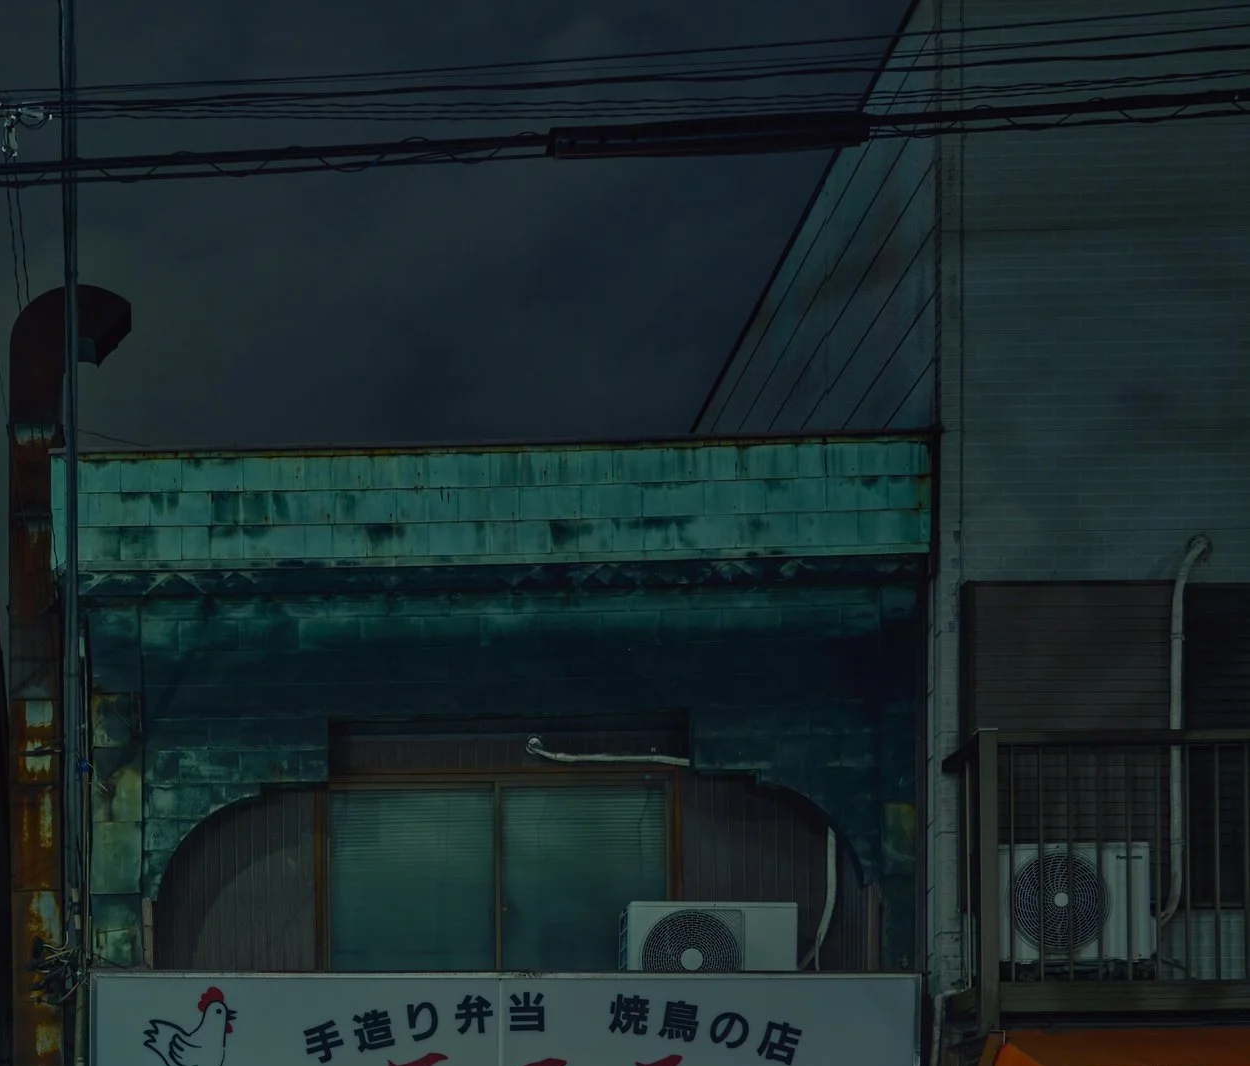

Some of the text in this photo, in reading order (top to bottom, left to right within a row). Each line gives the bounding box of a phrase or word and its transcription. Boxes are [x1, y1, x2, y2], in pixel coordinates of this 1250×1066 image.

[303, 991, 545, 1064] 手造り弁当
[609, 994, 802, 1065] 焼鳥の店
